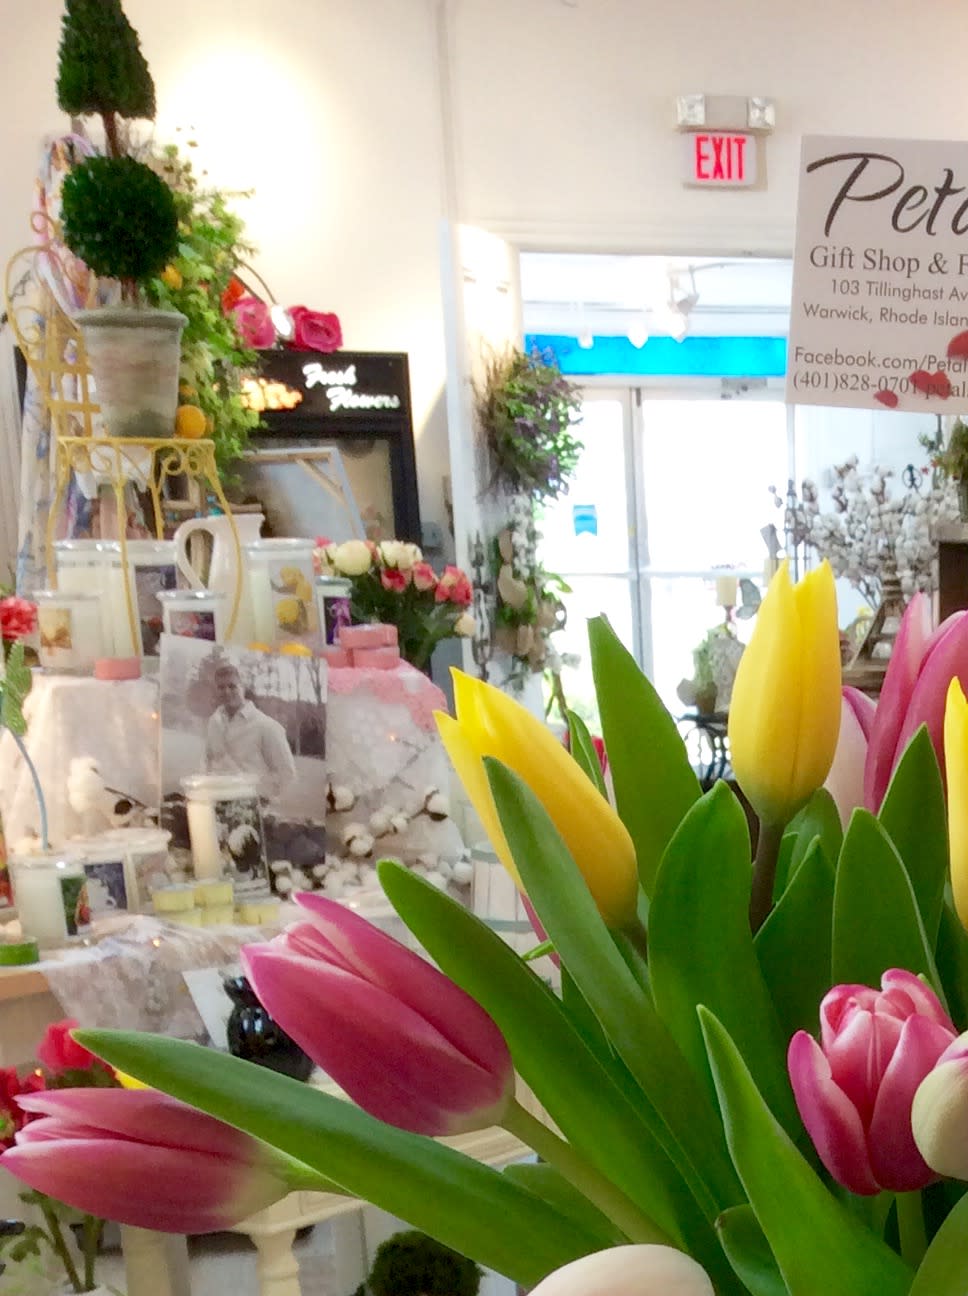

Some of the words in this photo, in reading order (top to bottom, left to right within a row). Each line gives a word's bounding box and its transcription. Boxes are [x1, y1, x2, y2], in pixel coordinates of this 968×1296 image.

[695, 135, 746, 180] EXIT
[809, 245, 856, 270] Gift
[862, 248, 920, 279] Shop
[928, 252, 949, 275] &
[831, 279, 860, 296] 103
[865, 281, 944, 302] Tillinghast
[803, 302, 874, 324] Warwick,
[879, 307, 928, 326] Rhode
